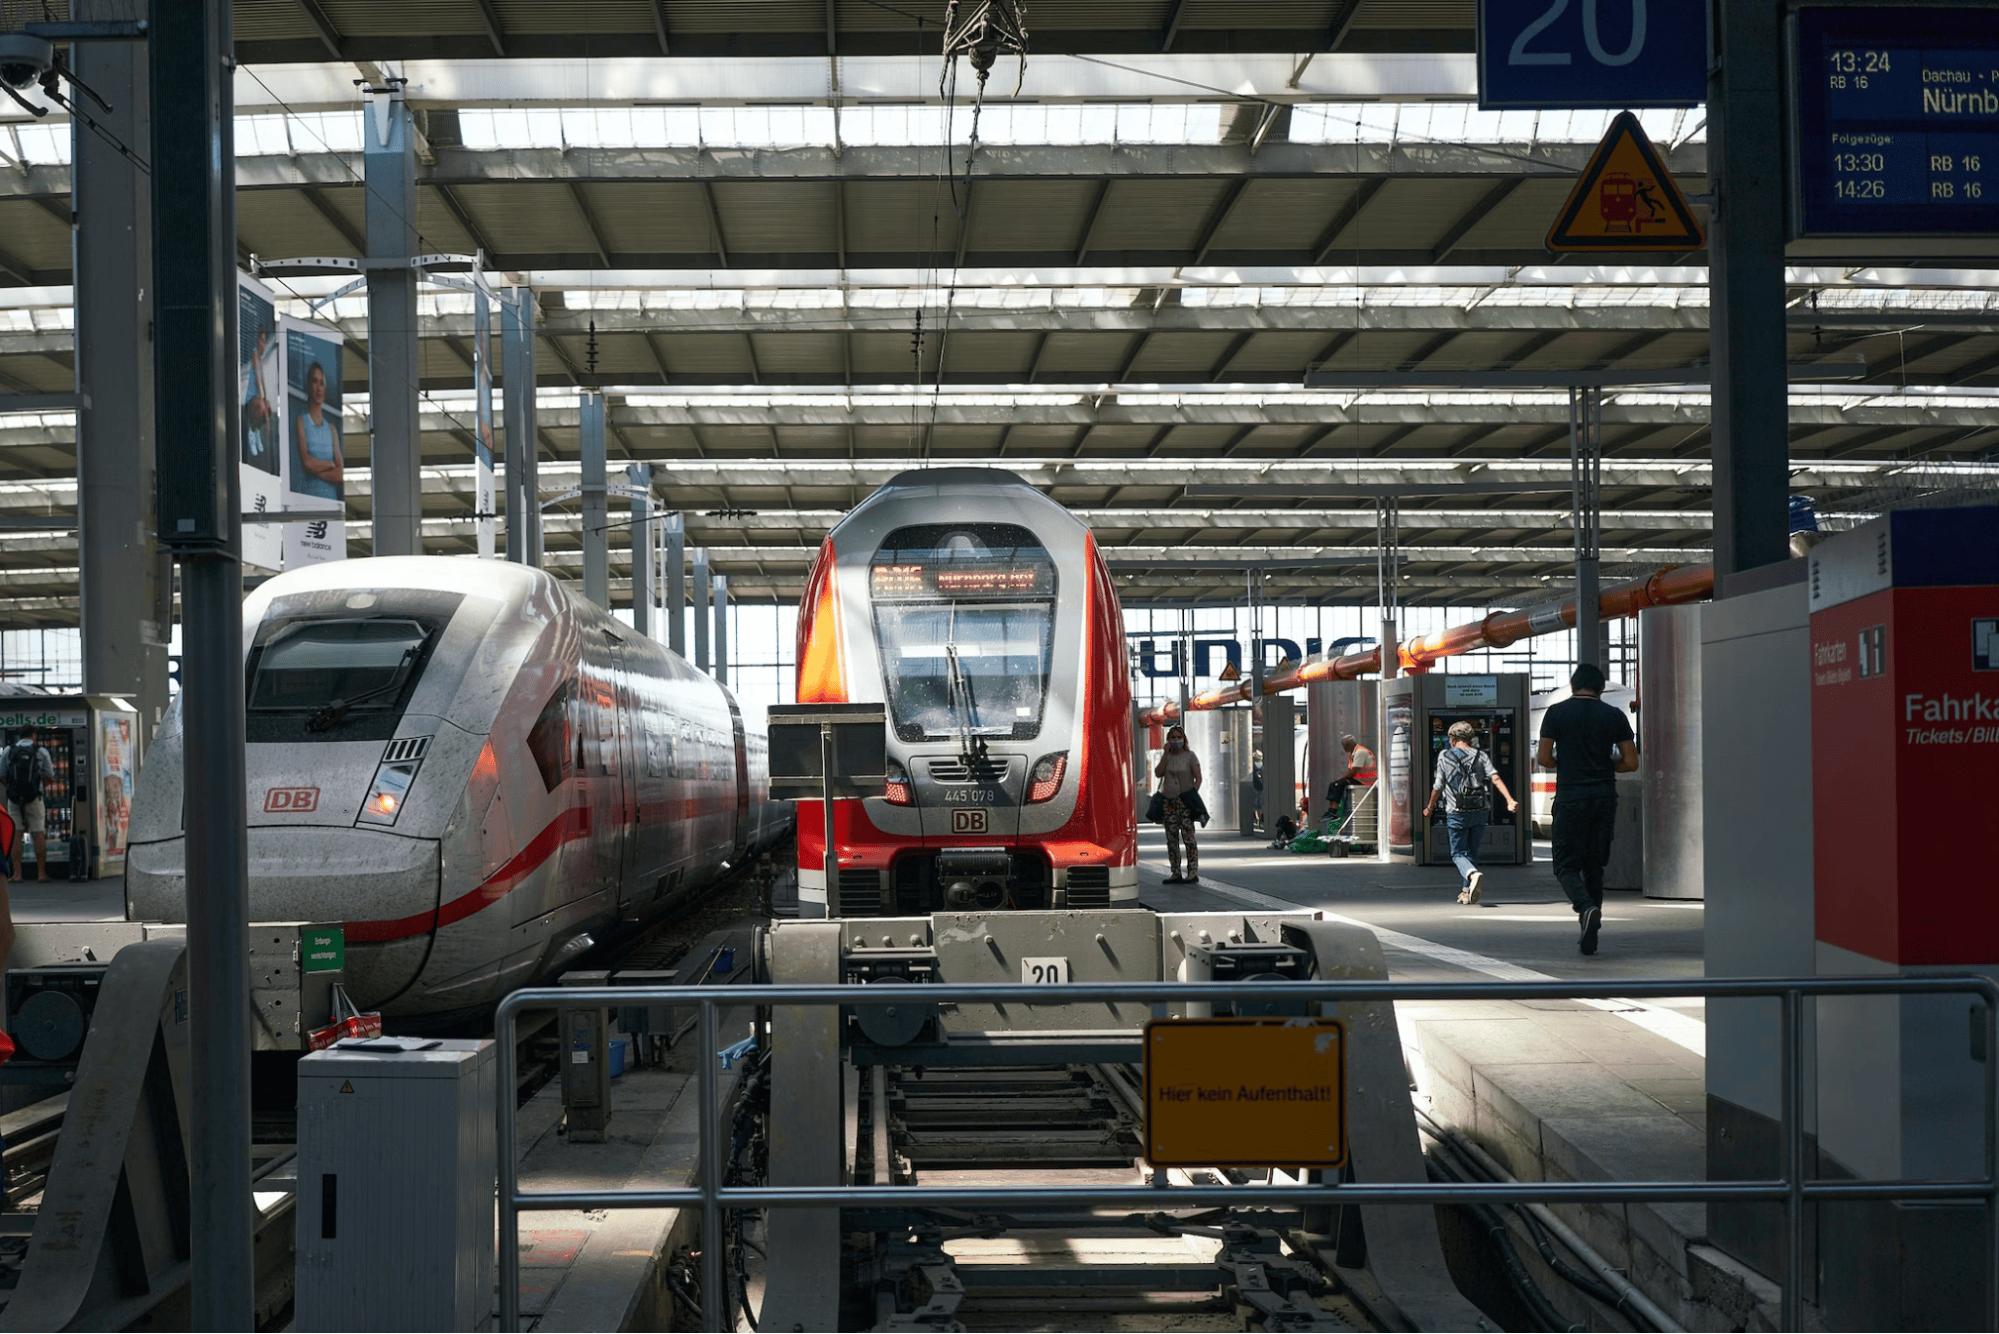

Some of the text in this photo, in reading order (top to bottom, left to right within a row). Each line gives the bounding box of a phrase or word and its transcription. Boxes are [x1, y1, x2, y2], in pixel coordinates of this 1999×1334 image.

[1508, 0, 1647, 66] 20
[1830, 51, 1891, 72] 13:24
[1830, 76, 1869, 89] RB 16
[1922, 69, 1971, 83] Dachau
[1923, 87, 1999, 114] Nürnb
[1832, 133, 1894, 146] Folgezüge:
[1834, 153, 1884, 172] 13:30
[1931, 155, 1981, 172] RB 16
[1835, 180, 1885, 199] 14:26
[1932, 181, 1982, 198] RB 16
[269, 790, 314, 810] DB
[945, 789, 994, 802] 445 078
[955, 812, 985, 831] DB
[1032, 964, 1059, 983] 20
[1159, 1085, 1331, 1102] Hier kein Aufenthalt!
